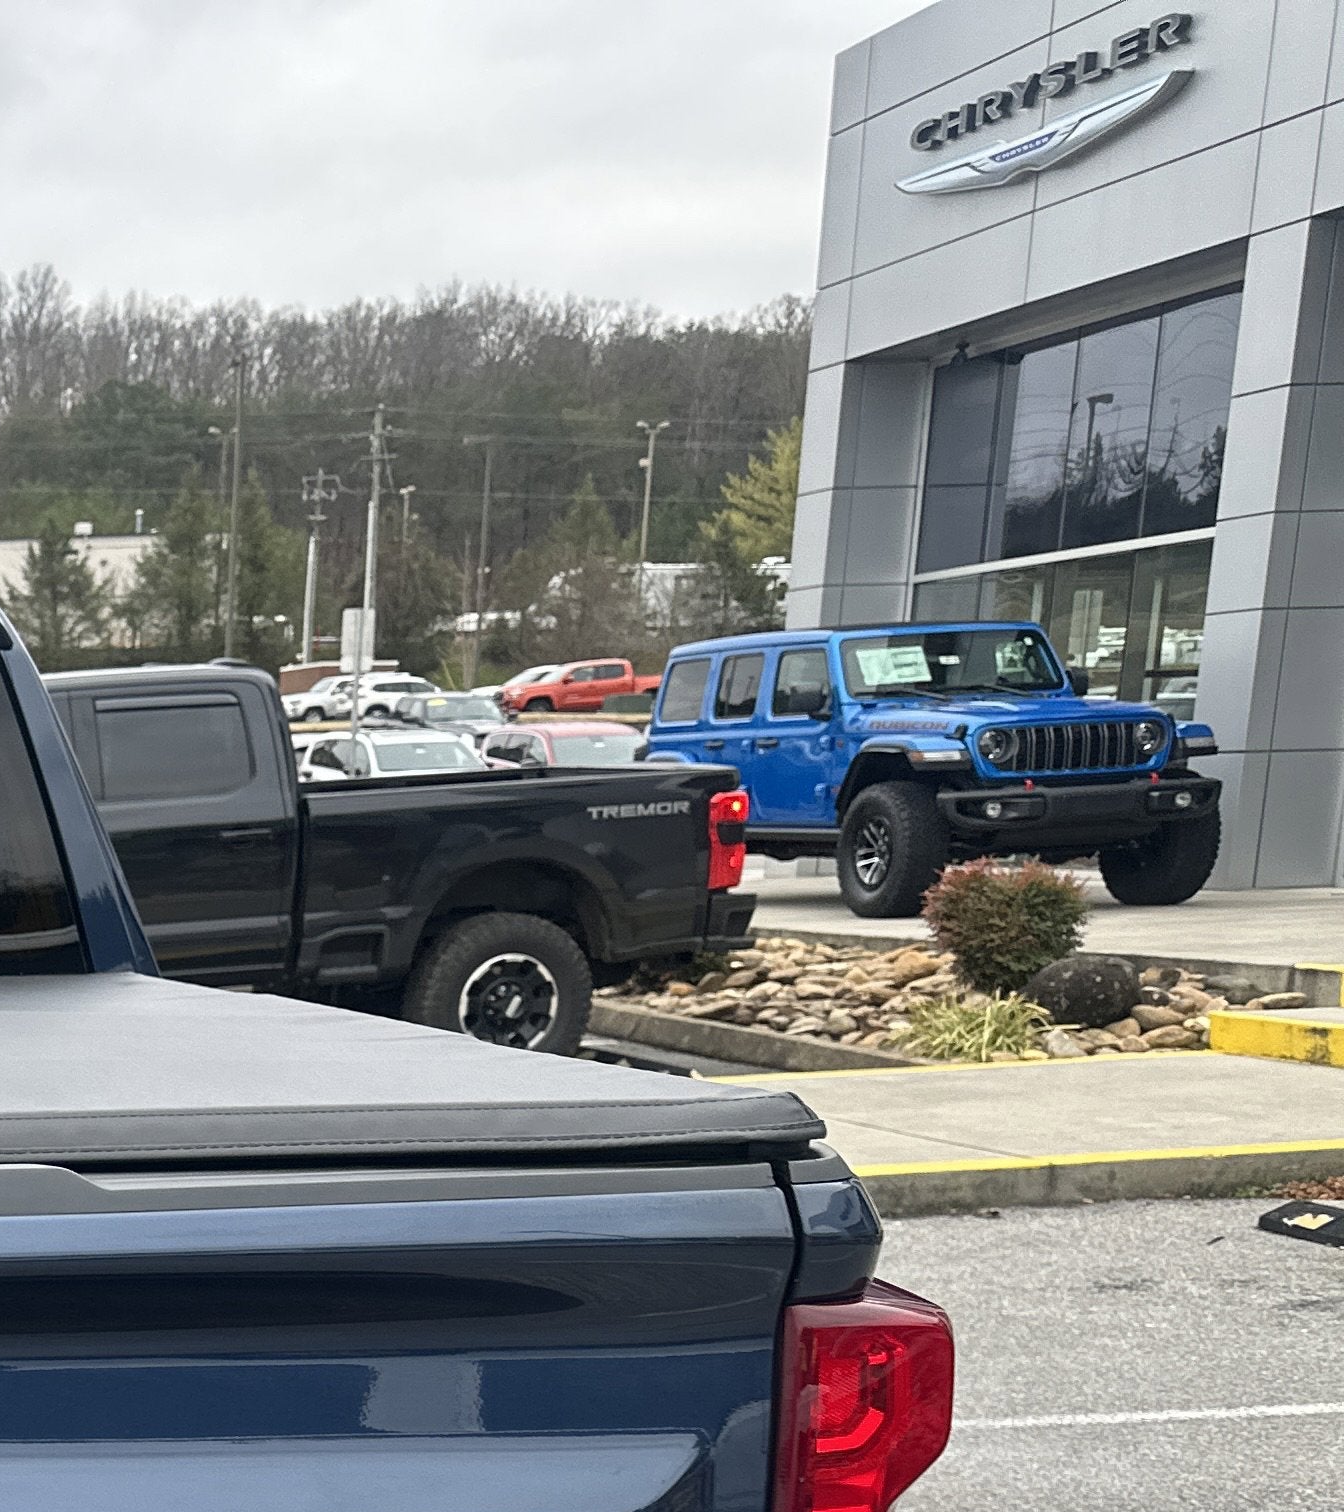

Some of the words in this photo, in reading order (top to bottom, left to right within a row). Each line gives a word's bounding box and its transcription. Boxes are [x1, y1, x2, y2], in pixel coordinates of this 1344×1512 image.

[910, 13, 1192, 150] CHRYSLER
[995, 137, 1049, 161] CHRYSLER
[586, 800, 691, 820] TREMOR
